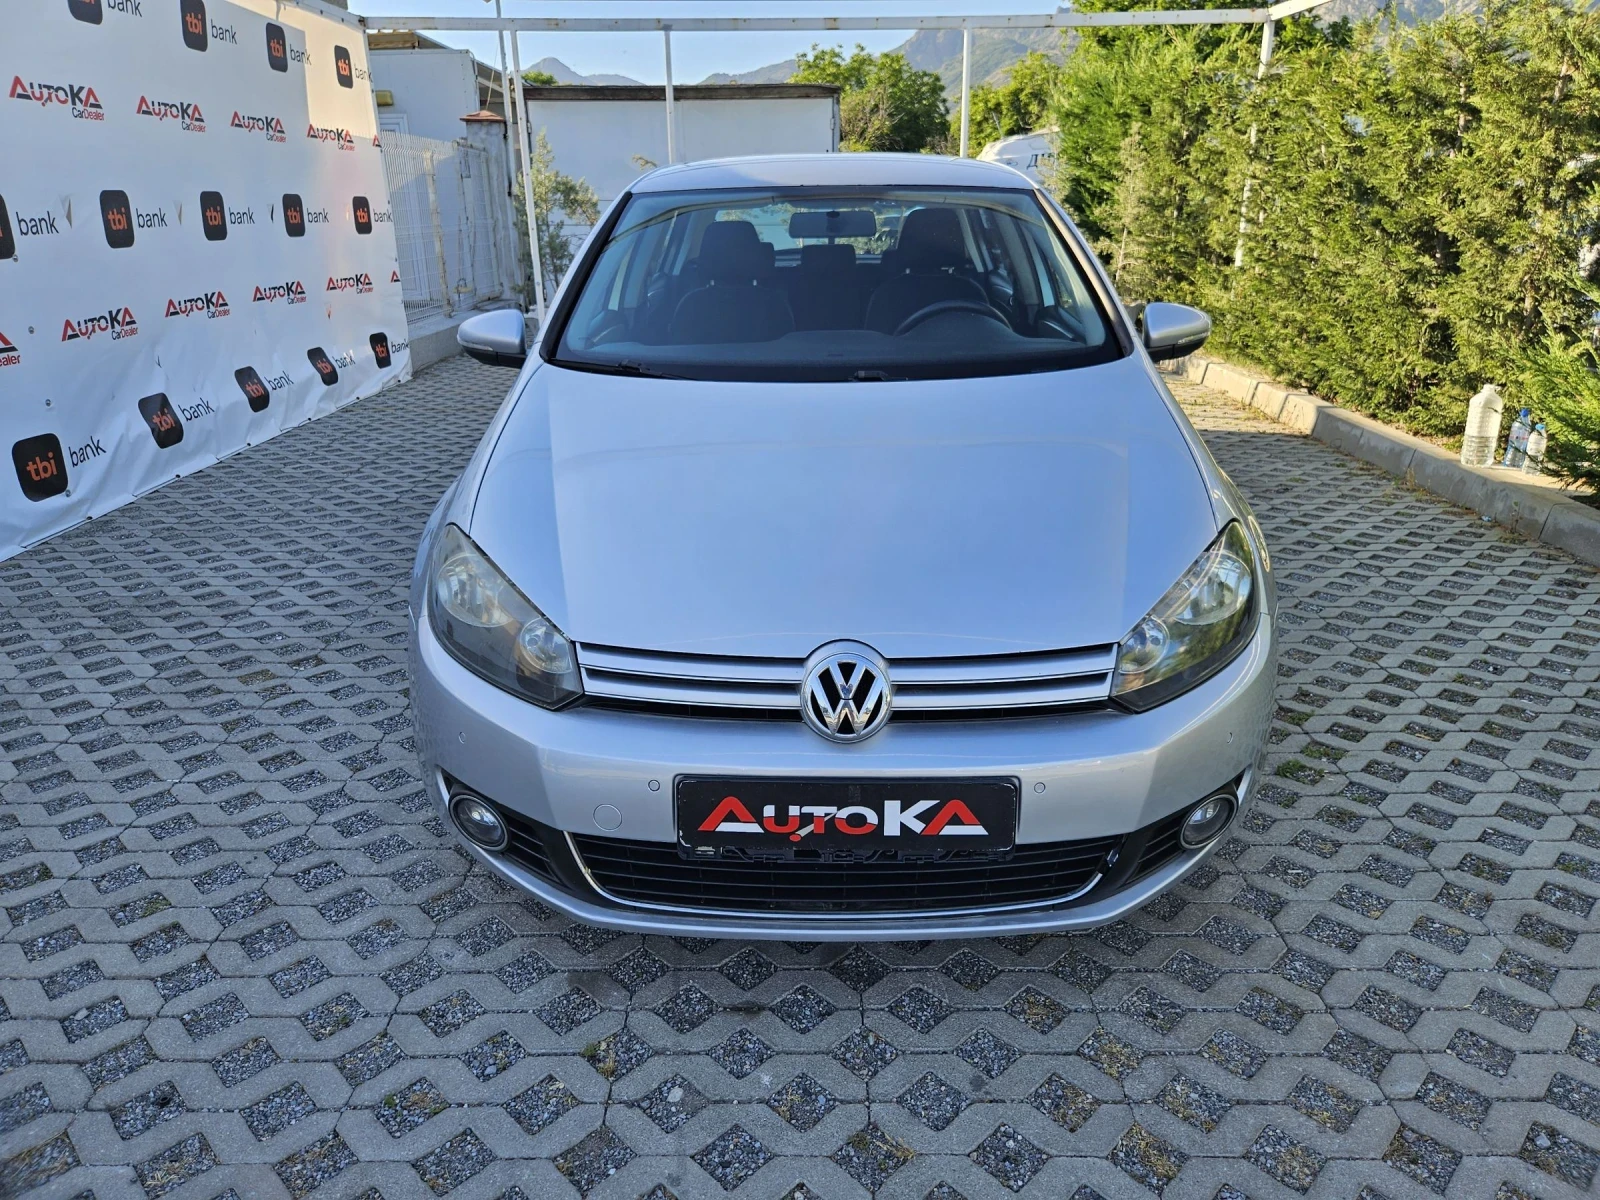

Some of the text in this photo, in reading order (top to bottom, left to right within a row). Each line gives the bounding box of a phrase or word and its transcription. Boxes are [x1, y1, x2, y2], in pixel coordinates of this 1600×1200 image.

[186, 13, 238, 45] tbi bank
[270, 38, 312, 66] tbi bank
[338, 59, 373, 83] tbi bank
[9, 75, 103, 109] AUTOKA
[136, 95, 205, 122] AUTOKA
[230, 111, 286, 135] AUTOKA
[15, 210, 60, 236] bank
[107, 207, 168, 231] tbi bank
[205, 206, 256, 226] tbi bank
[286, 207, 330, 224] tbi bank
[356, 207, 393, 224] tbi bank
[164, 290, 229, 318] AUTOKA
[252, 280, 306, 303] AUTOKA
[61, 306, 137, 342] AUTOKA
[375, 338, 410, 358] tbi bank
[316, 354, 356, 374] tbi bank
[245, 370, 295, 399] tbi bank
[152, 397, 216, 432] tbi bank
[26, 435, 107, 482] tbi bank
[697, 796, 990, 843] AUTOKA
